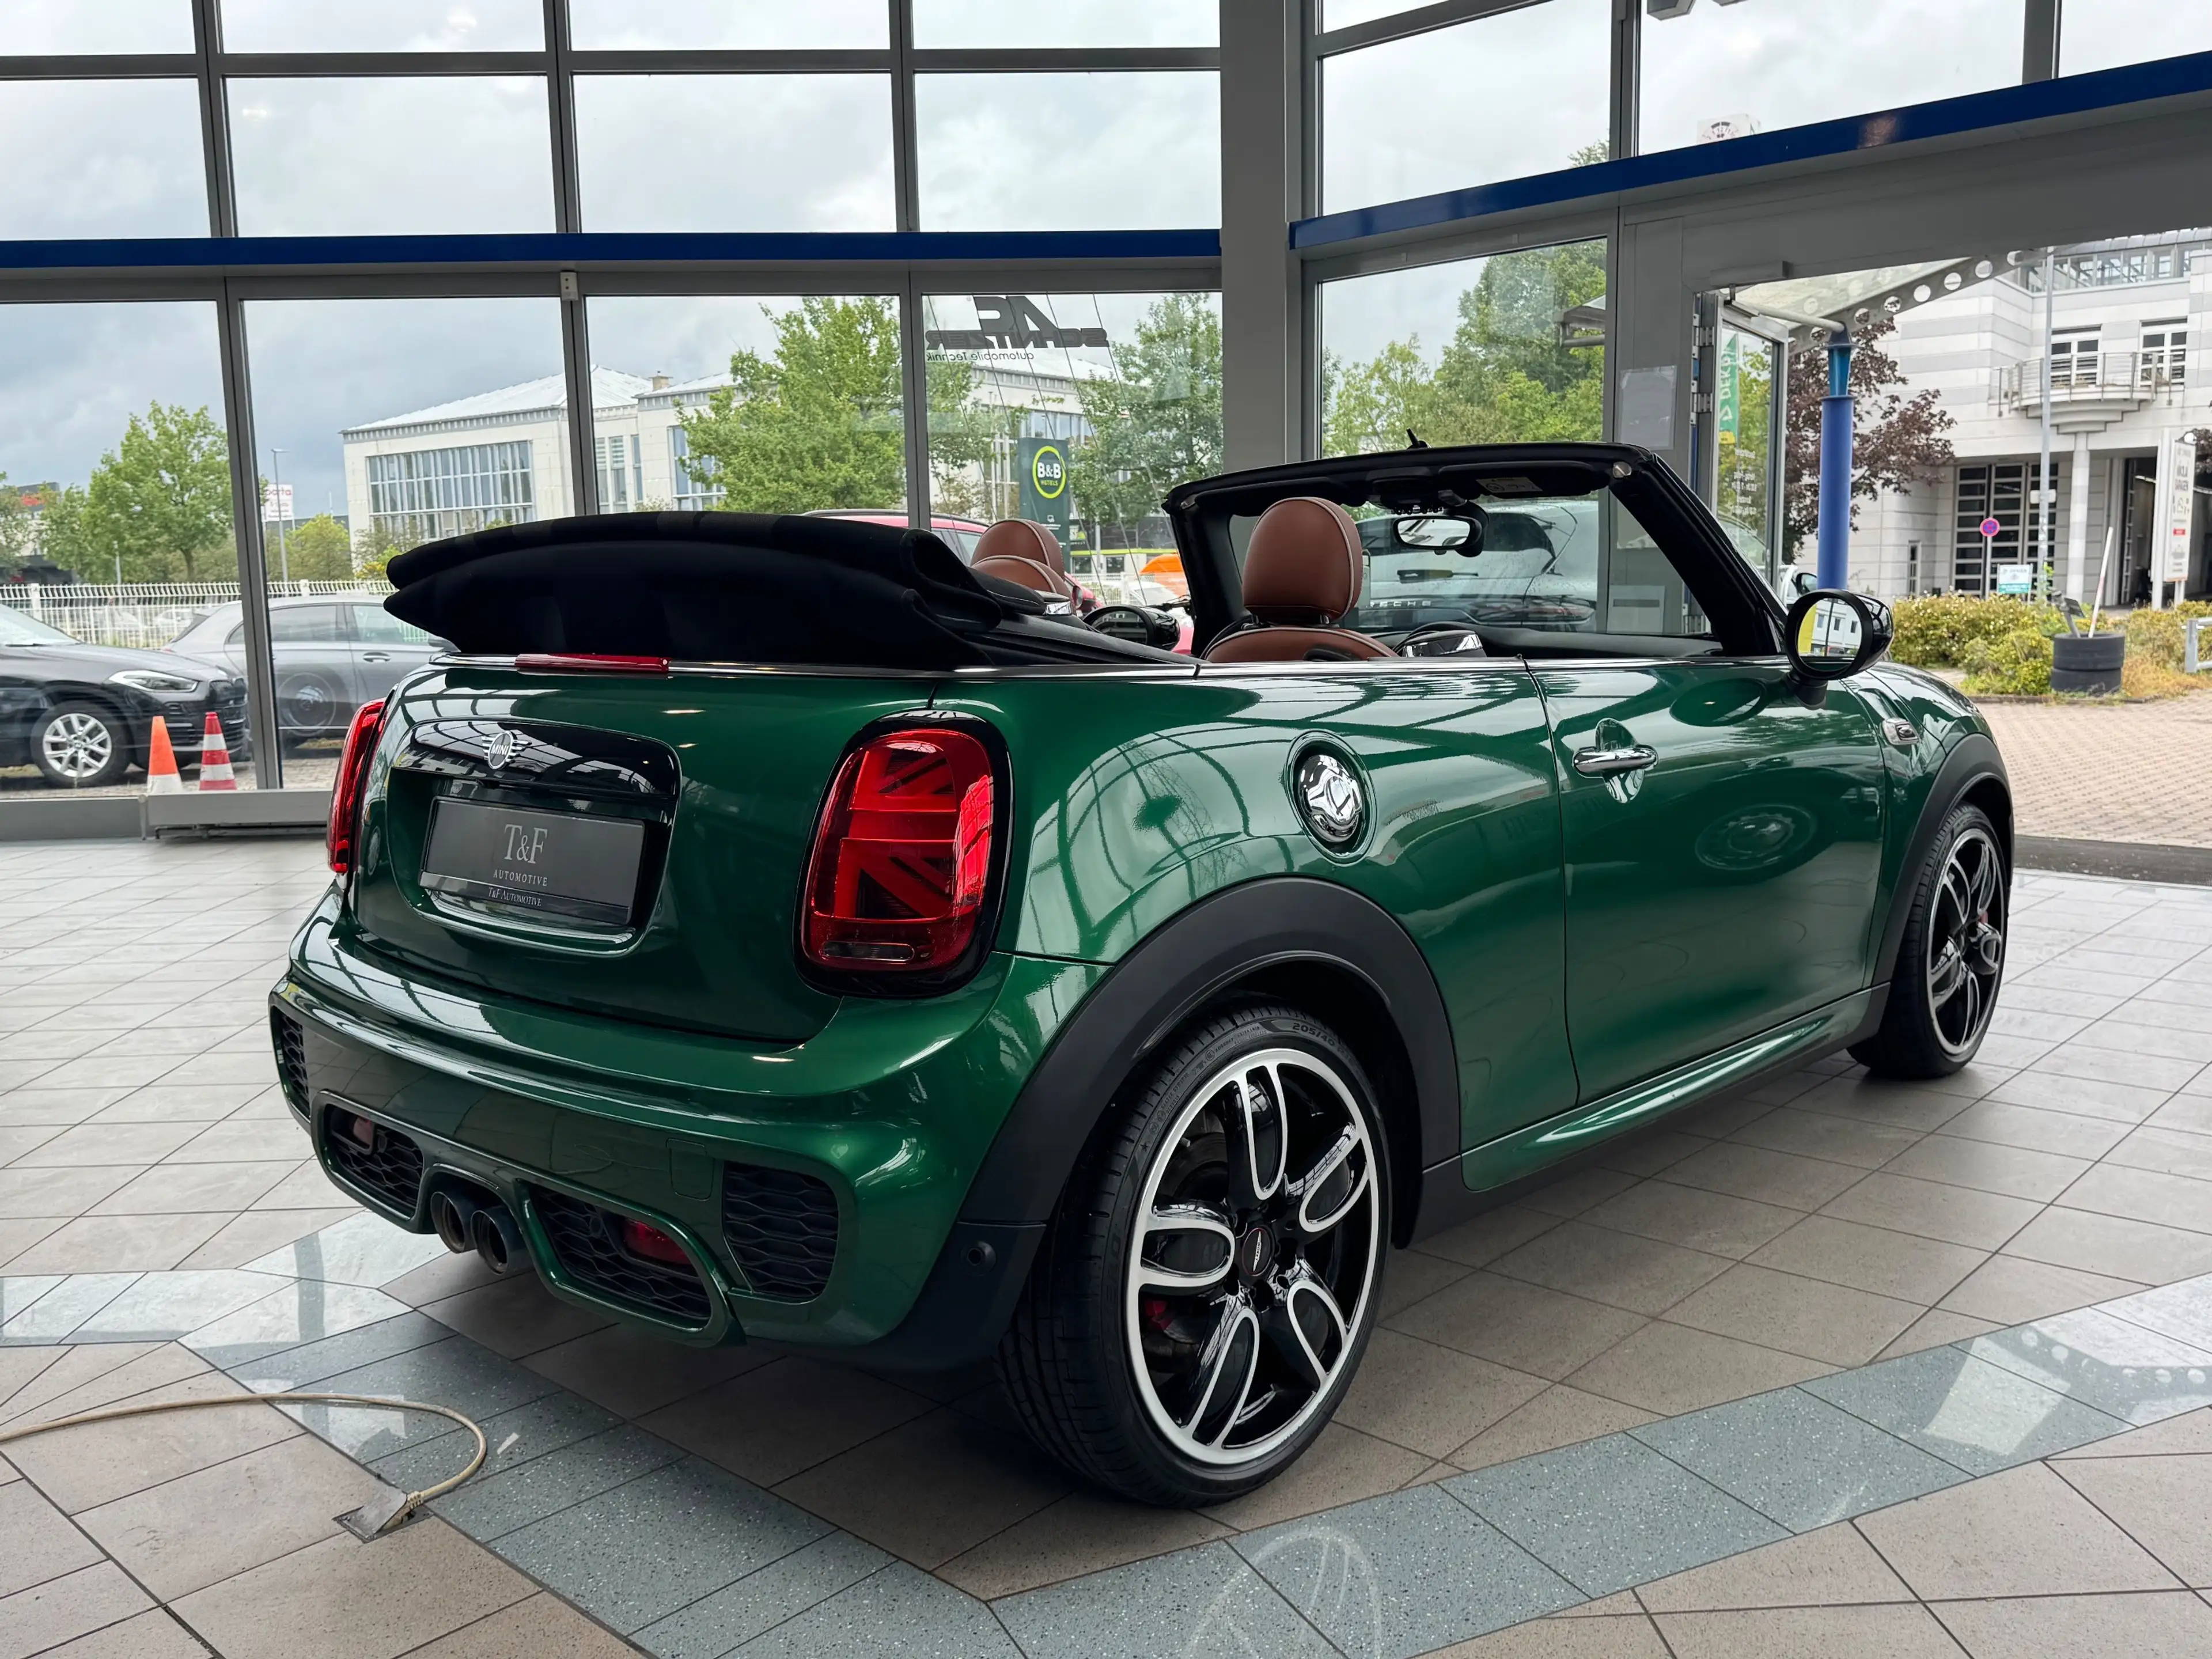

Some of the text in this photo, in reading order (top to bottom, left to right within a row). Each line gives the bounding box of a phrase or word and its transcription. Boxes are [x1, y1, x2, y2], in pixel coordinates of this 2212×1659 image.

[1037, 462, 1061, 479] B&B
[491, 744, 509, 755] MINI
[504, 824, 548, 864] T&F
[493, 869, 548, 887] AUTOMOTIVE
[488, 887, 542, 907] T&F AUTOMOTIVE
[1293, 1023, 1335, 1046] 205/40
